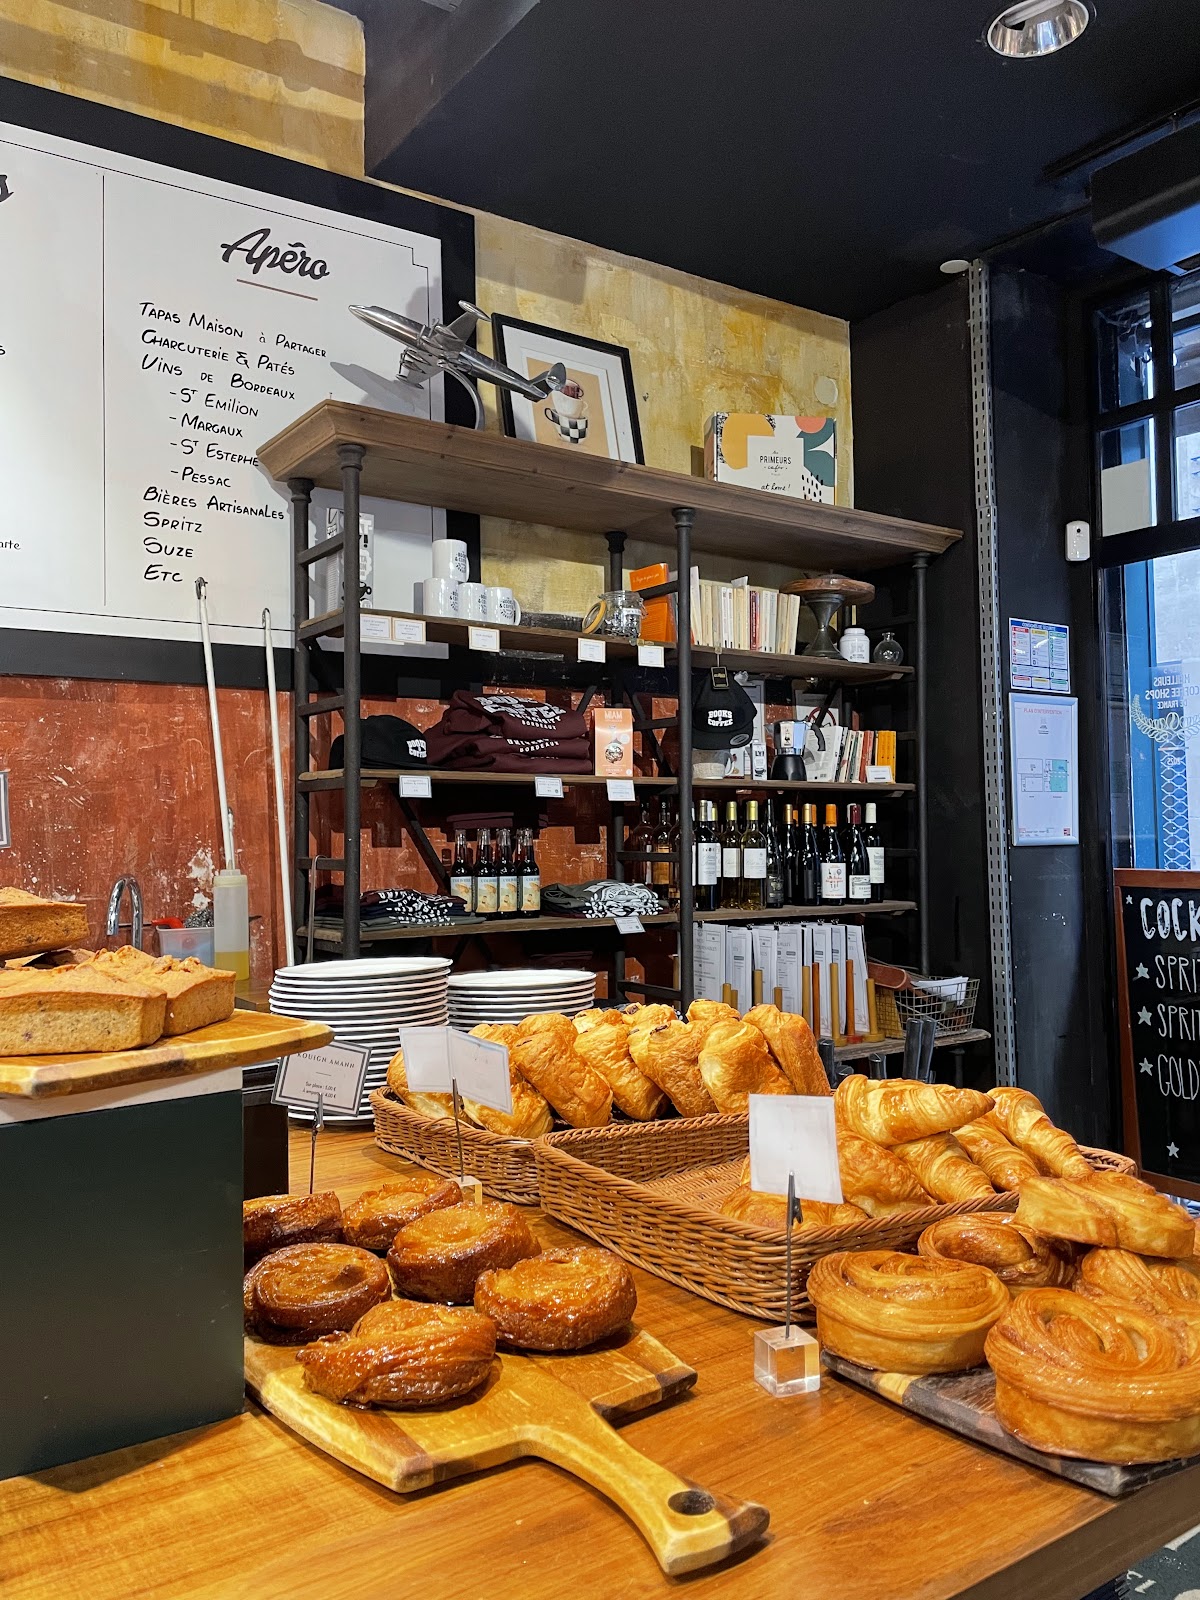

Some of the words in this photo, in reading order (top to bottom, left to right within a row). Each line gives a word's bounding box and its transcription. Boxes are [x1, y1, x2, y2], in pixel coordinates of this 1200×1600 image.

[139, 302, 181, 324] TAPAS
[189, 312, 243, 338] MAISON
[259, 332, 266, 343] à
[275, 333, 327, 358] PARTAGER
[141, 329, 229, 362] CHARCUTERIE
[236, 350, 249, 368] &
[257, 354, 295, 376] PATÉS
[141, 353, 183, 376] VINS
[200, 372, 213, 383] DE
[230, 373, 295, 400] BORDEAUX
[204, 393, 258, 417] EMILION
[206, 442, 260, 467] ESTEPHE
[759, 455, 792, 464] PRIMEURS
[143, 486, 197, 508] BIÈRES
[206, 495, 285, 520] ARTISANALES
[143, 511, 203, 533] SPRITZ
[143, 536, 194, 558] SUZE
[143, 564, 184, 582] ETC
[604, 710, 623, 720] MIAM
[707, 718, 734, 727] COFFEE
[708, 709, 733, 719] BOOKS
[519, 740, 560, 753] BORDEAUX
[297, 1052, 327, 1063] KOUIGN
[329, 1059, 355, 1069] AMANN
